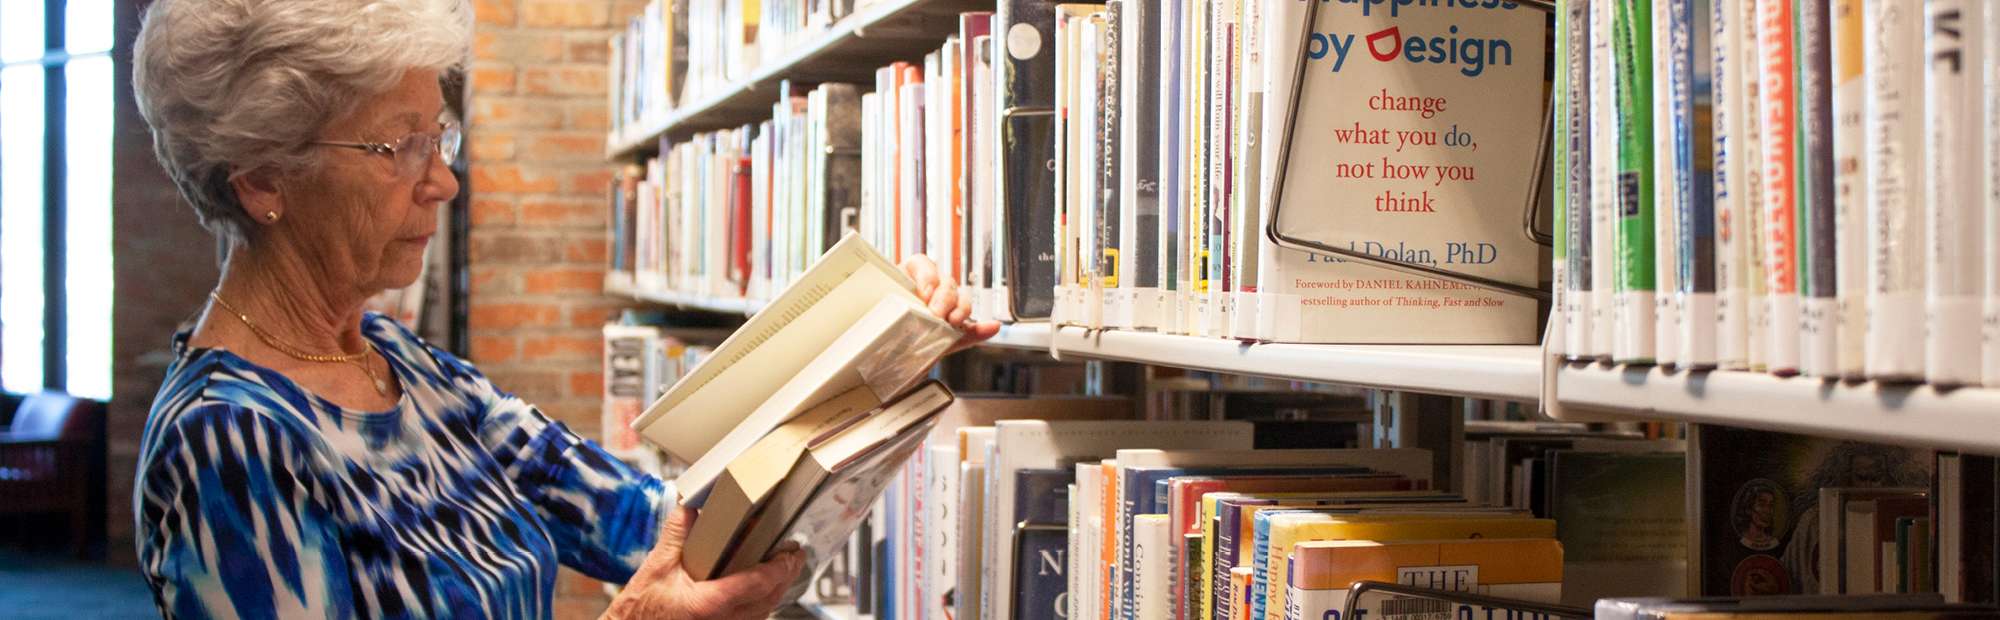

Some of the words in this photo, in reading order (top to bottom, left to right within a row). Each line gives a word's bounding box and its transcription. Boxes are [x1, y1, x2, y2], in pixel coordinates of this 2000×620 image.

[1366, 25, 1513, 77] Design
[1368, 88, 1446, 119] change
[1334, 122, 1390, 145] what
[1396, 129, 1437, 152] you
[1444, 124, 1477, 151] do,
[1336, 160, 1375, 178] not
[1382, 157, 1430, 179] how
[1435, 164, 1475, 186] you
[1715, 136, 1729, 200] Hurt
[1375, 190, 1437, 212] think
[1445, 242, 1497, 265] PhD
[1295, 279, 1341, 290] Foreword
[1342, 279, 1356, 293] by
[1356, 279, 1403, 290] DANIEL
[1350, 297, 1381, 306] author
[1382, 297, 1393, 306] of
[1395, 297, 1441, 309] Thinking,
[1443, 297, 1462, 307] Fast
[1463, 297, 1481, 307] and
[1483, 297, 1505, 307] Slow
[1123, 500, 1135, 572] beyond
[1267, 545, 1283, 605] Happy
[1404, 569, 1469, 592] THE
